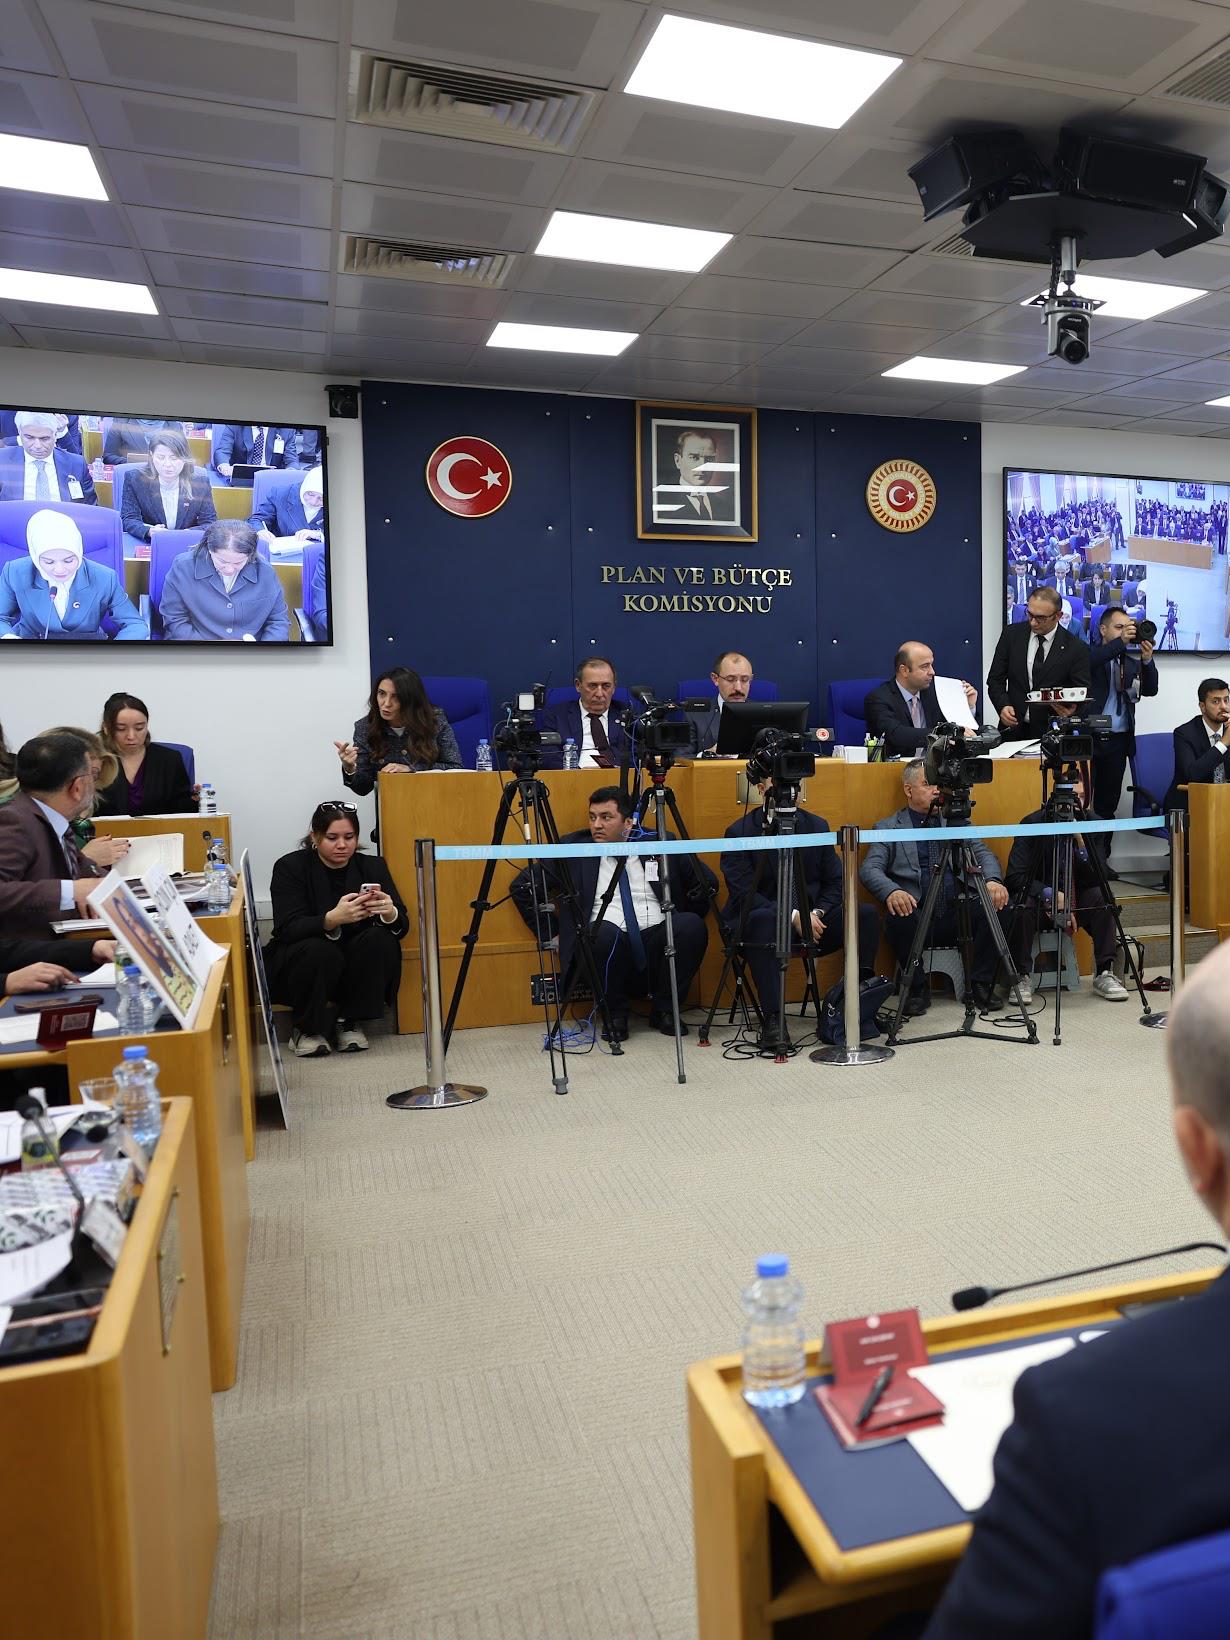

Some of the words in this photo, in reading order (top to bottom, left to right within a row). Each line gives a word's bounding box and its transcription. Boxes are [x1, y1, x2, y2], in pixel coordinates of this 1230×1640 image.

[601, 565, 666, 584] PLAN
[673, 567, 706, 585] VE
[712, 563, 793, 591] BÜTÇE
[623, 590, 773, 613] KOMİSYONU
